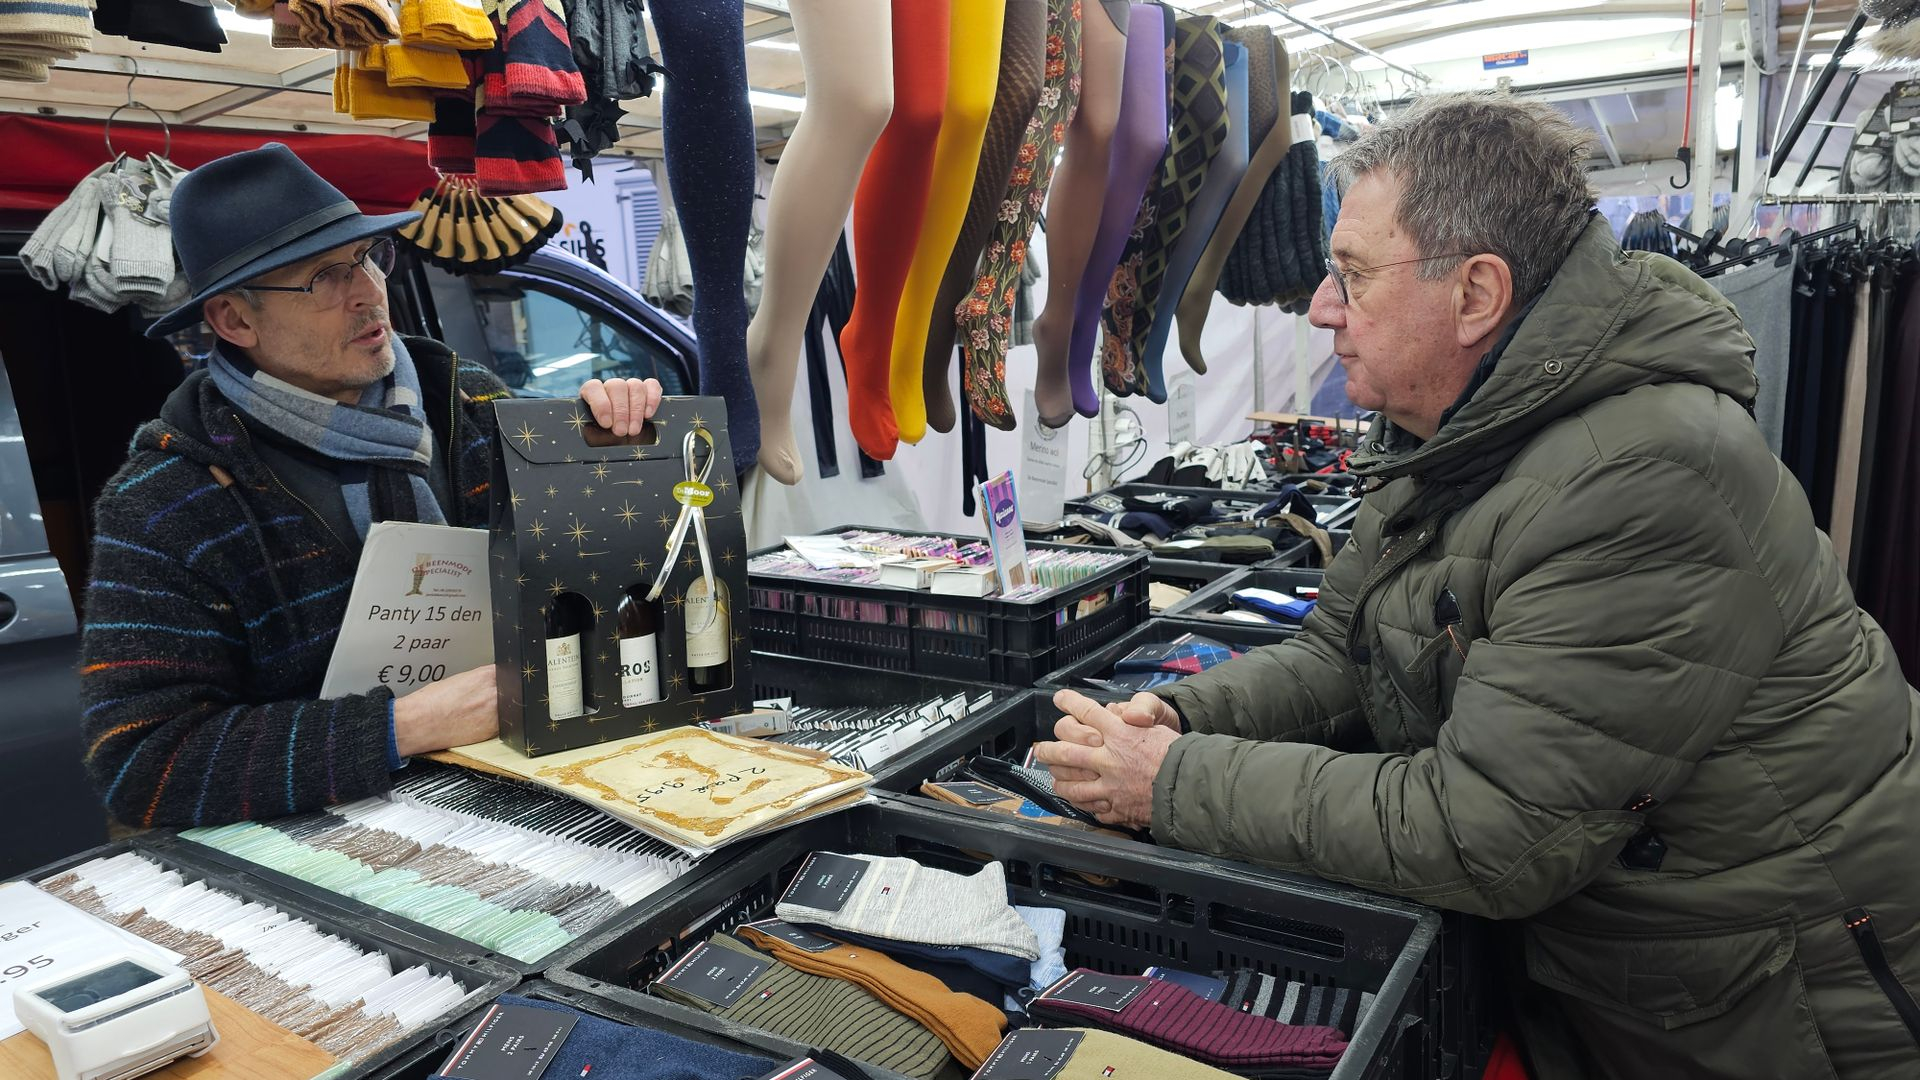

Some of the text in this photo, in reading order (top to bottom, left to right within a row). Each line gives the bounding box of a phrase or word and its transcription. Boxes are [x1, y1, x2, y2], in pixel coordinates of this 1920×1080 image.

[684, 486, 710, 497] Moor
[426, 559, 472, 576] BEENMODE
[368, 605, 482, 625] Panty 15 den
[393, 635, 450, 653] 2 paar
[377, 664, 446, 687] € 9,00
[0, 920, 40, 942] ger
[458, 1011, 504, 1070] TOMMY HILFIGER
[500, 1036, 515, 1052] MENS
[510, 1035, 525, 1051] PAIRS
